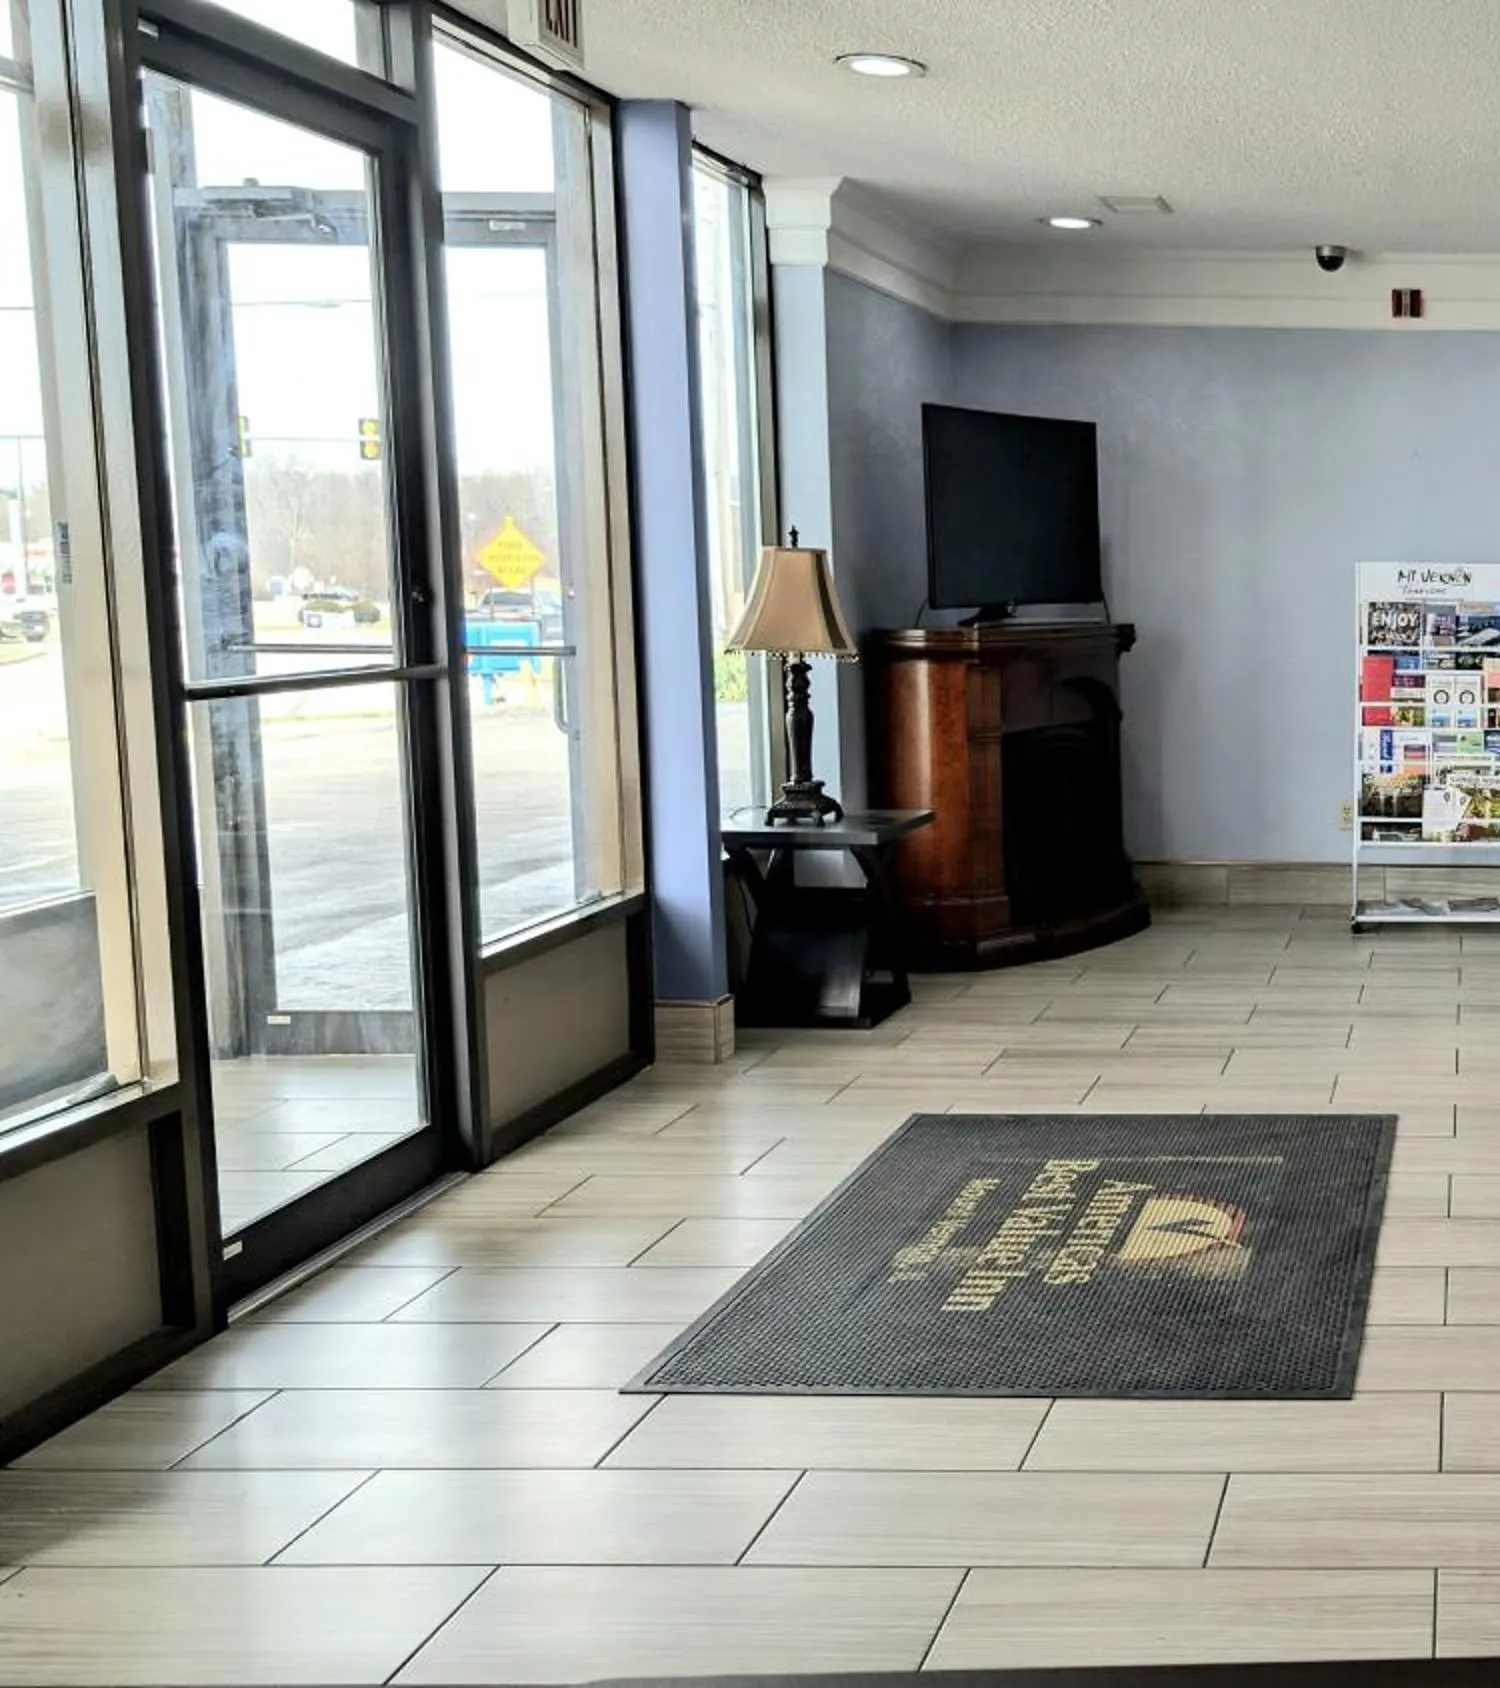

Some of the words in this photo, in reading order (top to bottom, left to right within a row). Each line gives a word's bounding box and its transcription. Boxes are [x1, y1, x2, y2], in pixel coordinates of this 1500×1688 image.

[1372, 612, 1418, 630] ENJOY
[942, 1179, 1000, 1215] Mount
[1021, 1160, 1098, 1199] Best
[973, 1205, 1072, 1264] Value
[1042, 1180, 1156, 1283] Americas
[940, 1271, 1029, 1311] Inn
